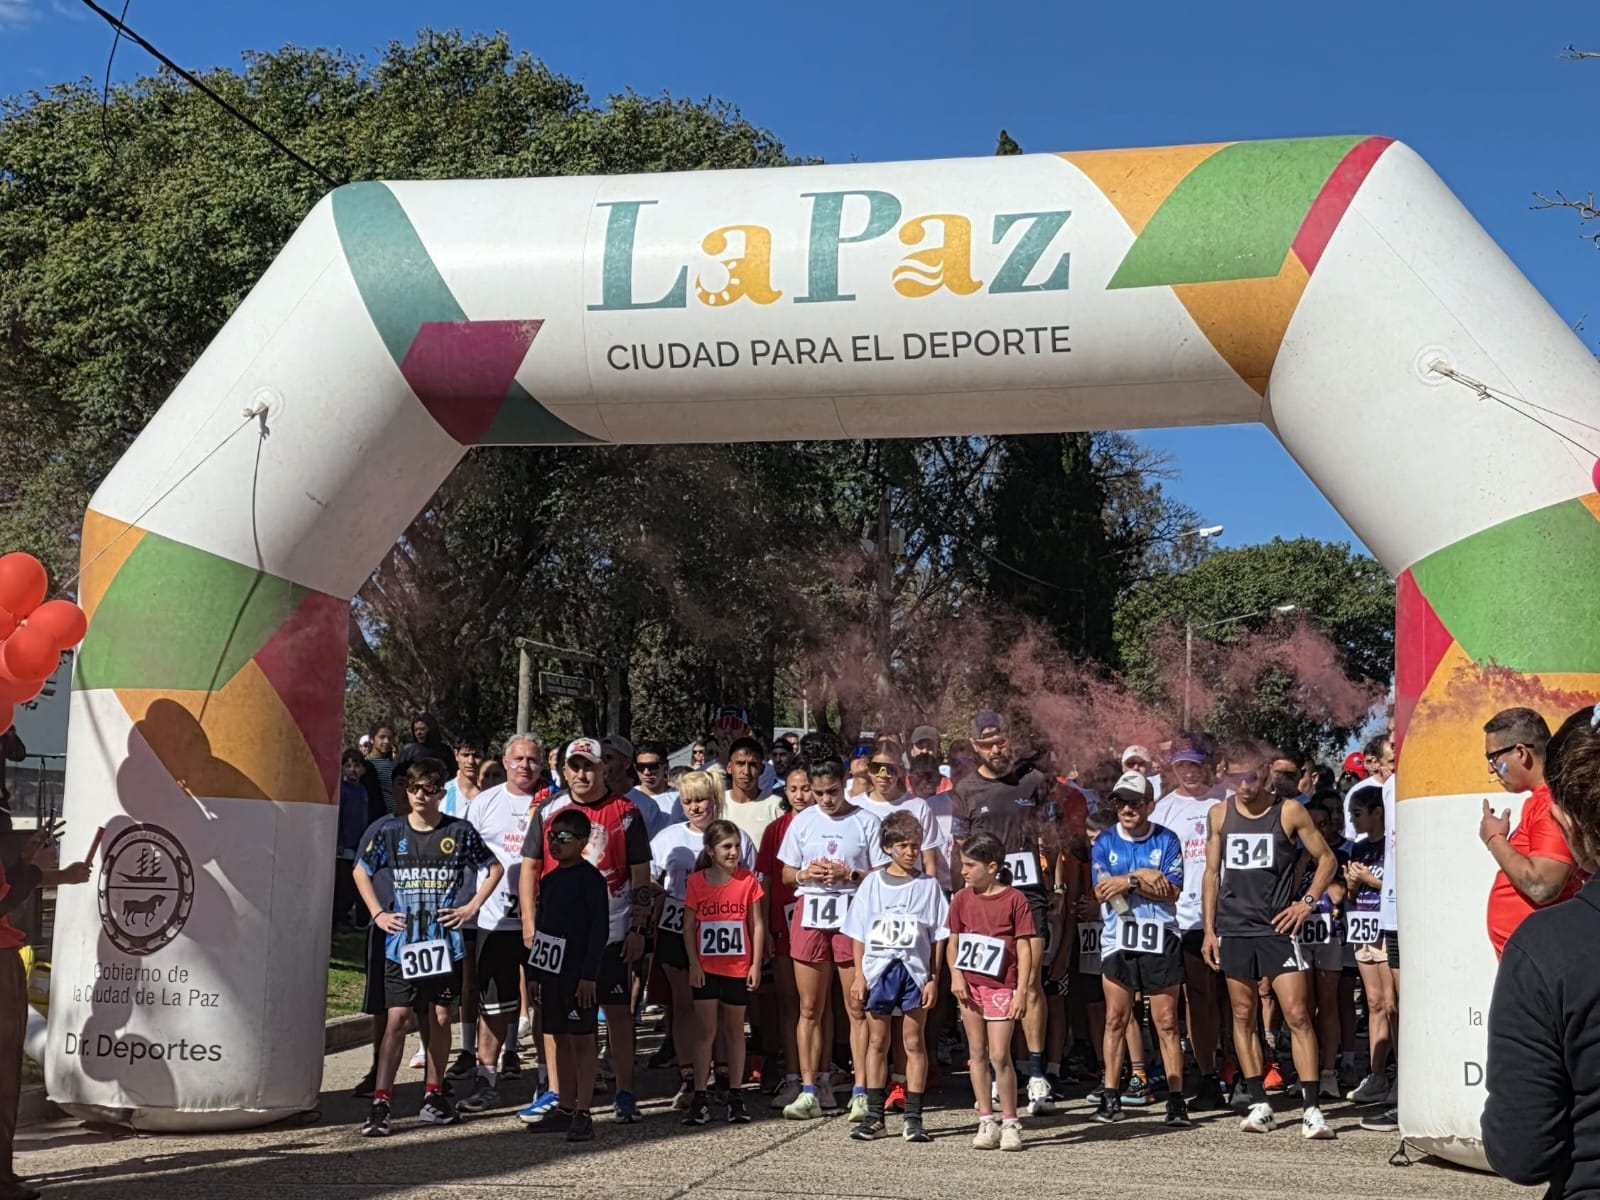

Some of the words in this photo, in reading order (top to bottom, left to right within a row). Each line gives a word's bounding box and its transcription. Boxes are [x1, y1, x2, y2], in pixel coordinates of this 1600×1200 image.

[793, 189, 1073, 304] Paz
[606, 341, 740, 371] CIUDAD
[751, 336, 843, 366] PARA
[851, 335, 894, 362] EL
[903, 326, 1072, 361] DEPORTE
[1231, 838, 1271, 867] 34
[393, 866, 458, 881] MARATÓN
[662, 905, 685, 931] 23
[808, 898, 840, 925] 14
[702, 928, 743, 954] 264
[1082, 928, 1103, 952] 20
[1121, 921, 1159, 951] 09
[1299, 920, 1327, 944] 60
[1350, 918, 1379, 942] 259
[403, 945, 446, 977] 307
[533, 938, 562, 972] 250
[958, 941, 1001, 971] 267
[93, 962, 162, 983] Gobierno
[167, 965, 189, 984] de
[73, 985, 82, 1002] la
[84, 984, 131, 1005] Ciudad
[135, 987, 155, 1006] de
[161, 988, 182, 1007] La
[188, 989, 220, 1008] Paz
[1469, 1006, 1483, 1026] la
[65, 1032, 90, 1057] Dir.
[97, 1034, 223, 1066] Deportes
[1464, 1061, 1483, 1086] D
